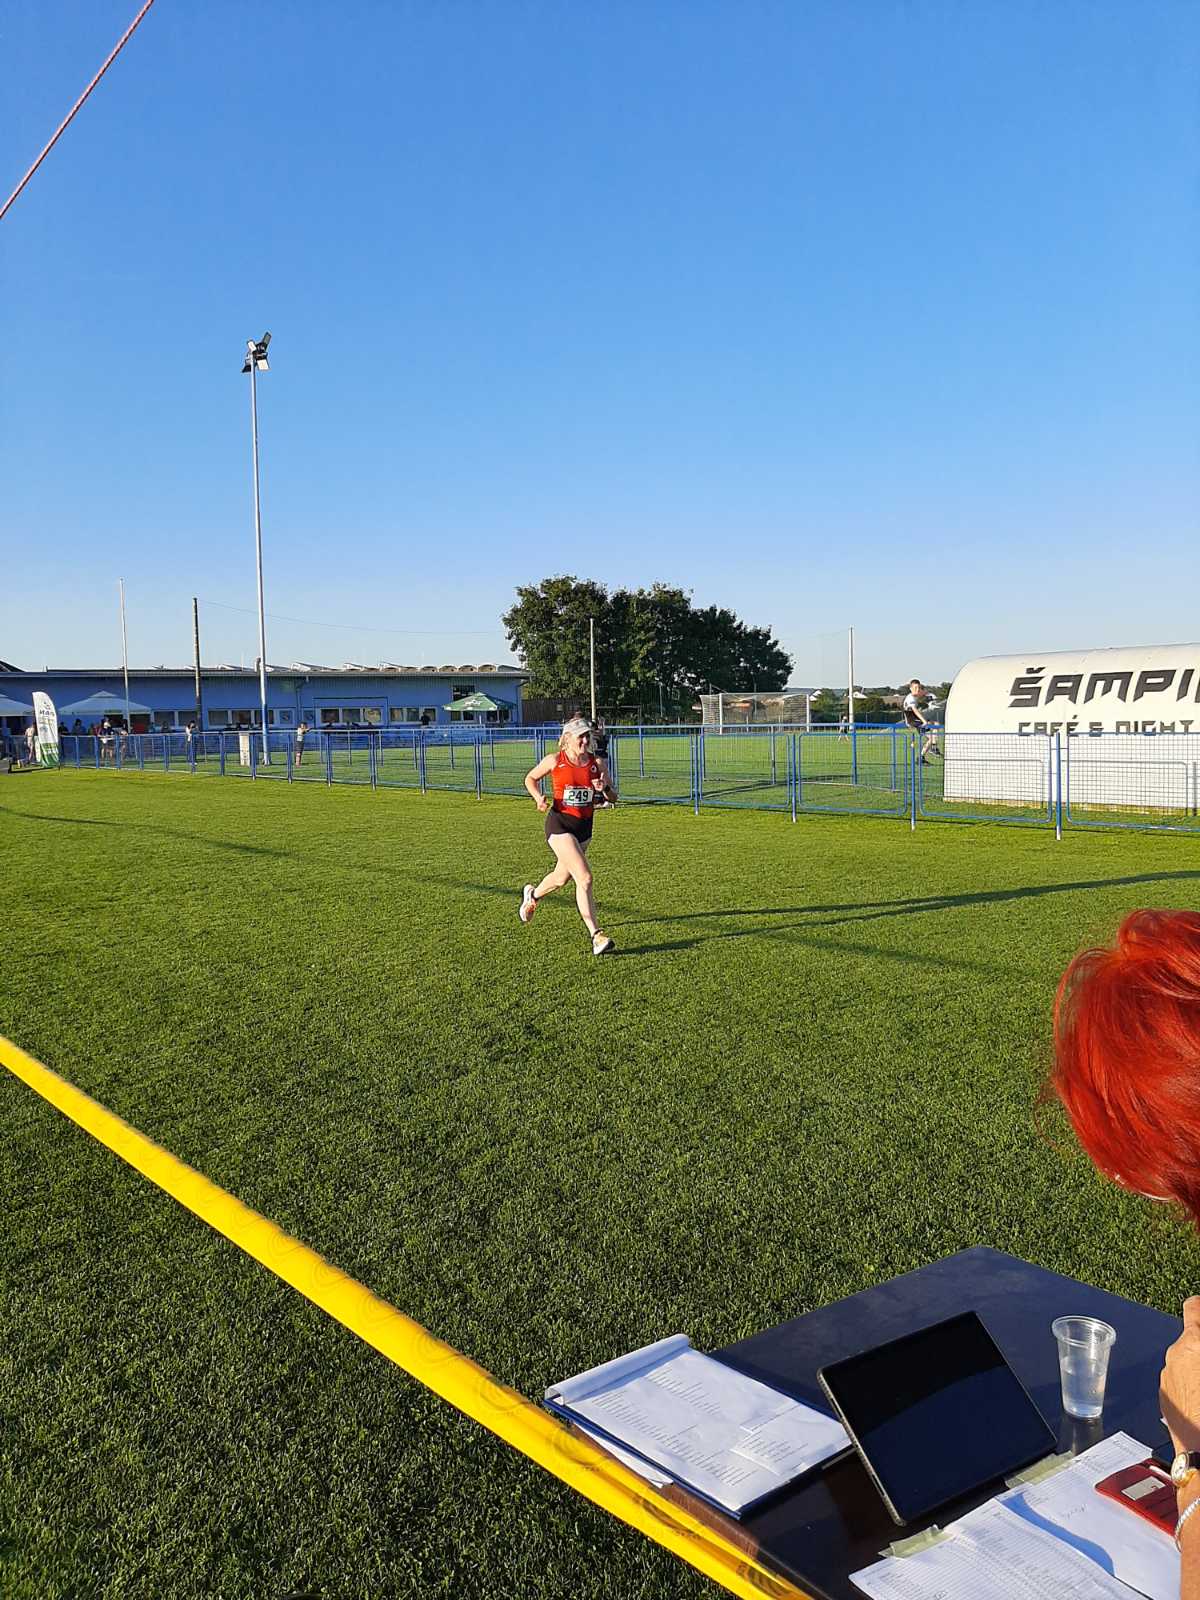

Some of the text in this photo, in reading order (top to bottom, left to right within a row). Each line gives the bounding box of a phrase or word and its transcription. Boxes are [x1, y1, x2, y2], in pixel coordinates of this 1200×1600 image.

[1008, 666, 1200, 708] ŠAMPI
[1018, 715, 1079, 736] CAFÉ
[1115, 720, 1194, 736] NIGHT
[568, 790, 589, 802] 249
